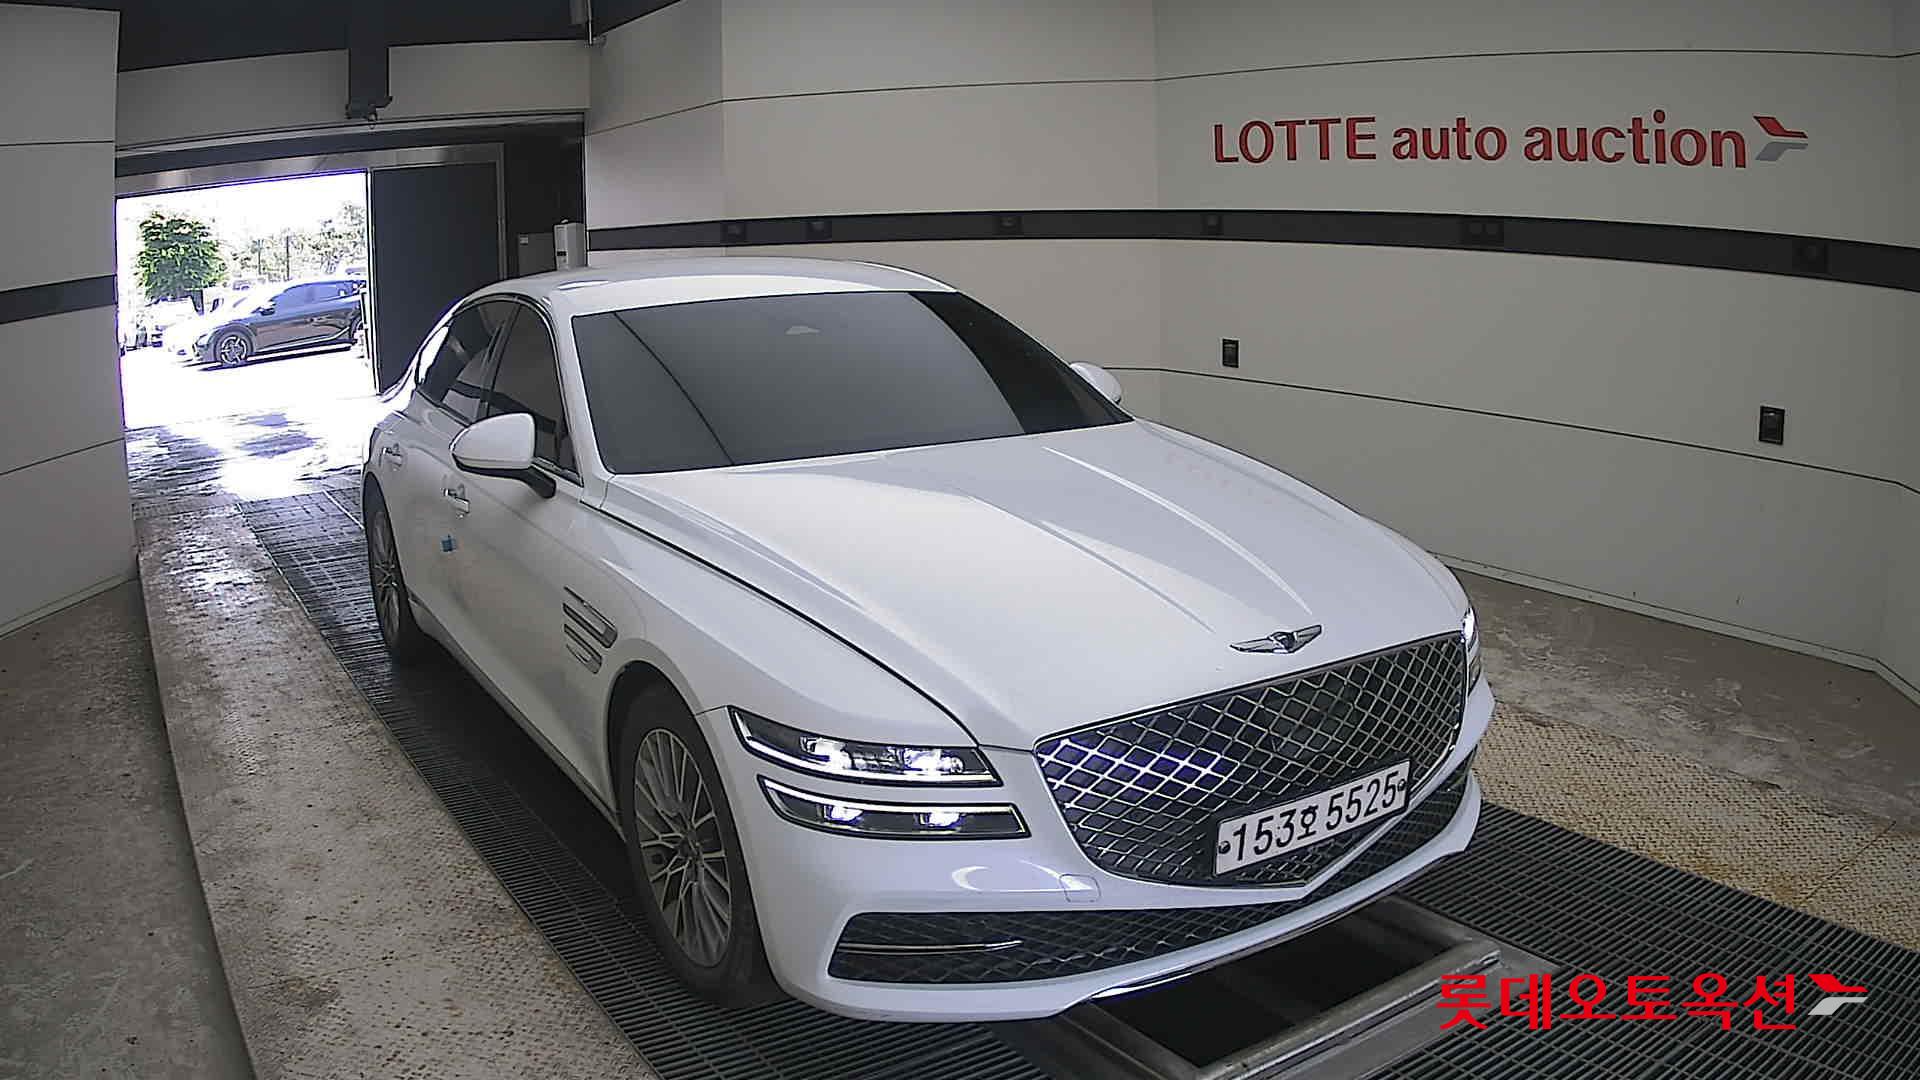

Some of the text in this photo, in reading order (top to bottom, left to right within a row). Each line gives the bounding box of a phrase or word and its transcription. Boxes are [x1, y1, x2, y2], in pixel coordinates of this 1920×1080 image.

[1213, 110, 1746, 168] LOTTE auto auction
[1326, 772, 1398, 830] 5525
